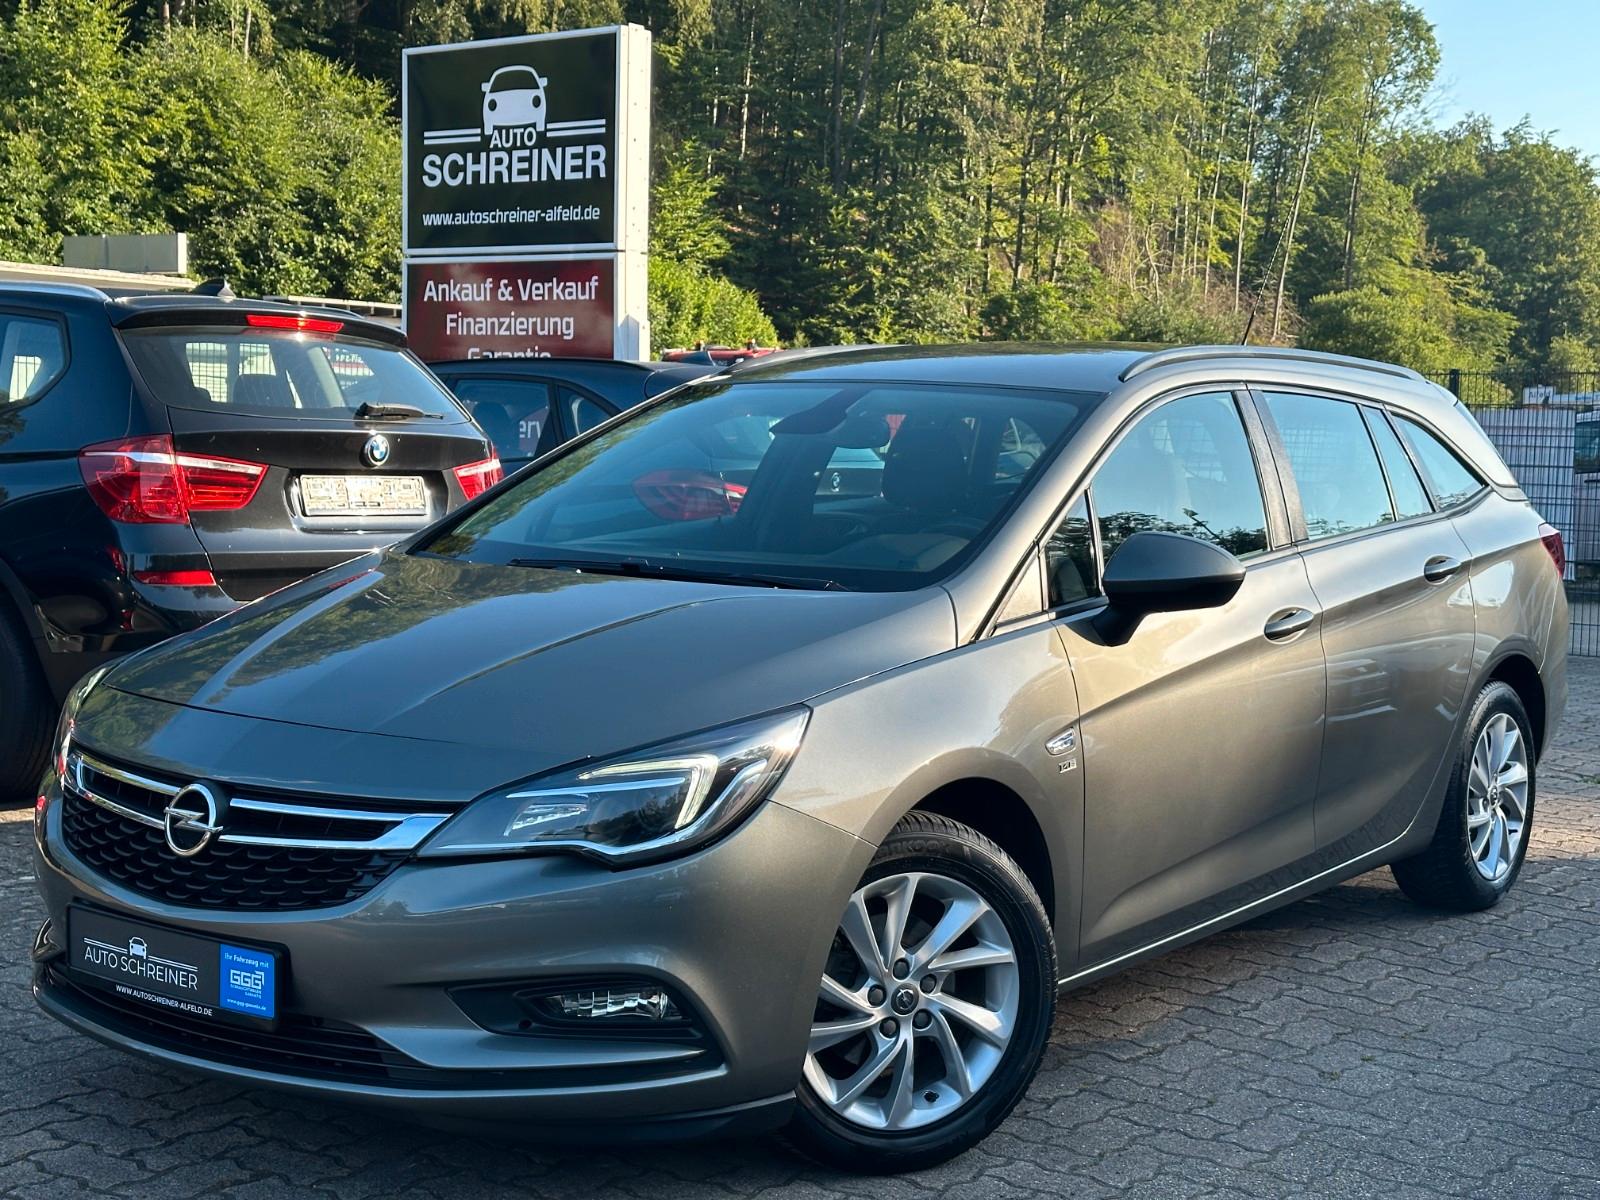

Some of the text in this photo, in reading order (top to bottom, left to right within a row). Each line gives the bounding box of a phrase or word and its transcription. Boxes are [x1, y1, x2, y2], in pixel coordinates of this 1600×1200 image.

[489, 127, 537, 148] AUTO
[422, 144, 607, 188] SCHREINER
[422, 205, 601, 226] www.autoschreiner-alfeld.de
[423, 275, 599, 302] Ankauf & Verkauf
[446, 311, 574, 340] Finanzierung
[84, 946, 198, 991] AUTO SCHREINER
[230, 969, 264, 989] GGG
[115, 983, 213, 1016] WWW.AUTOSCHREINER-ALFELD.DE
